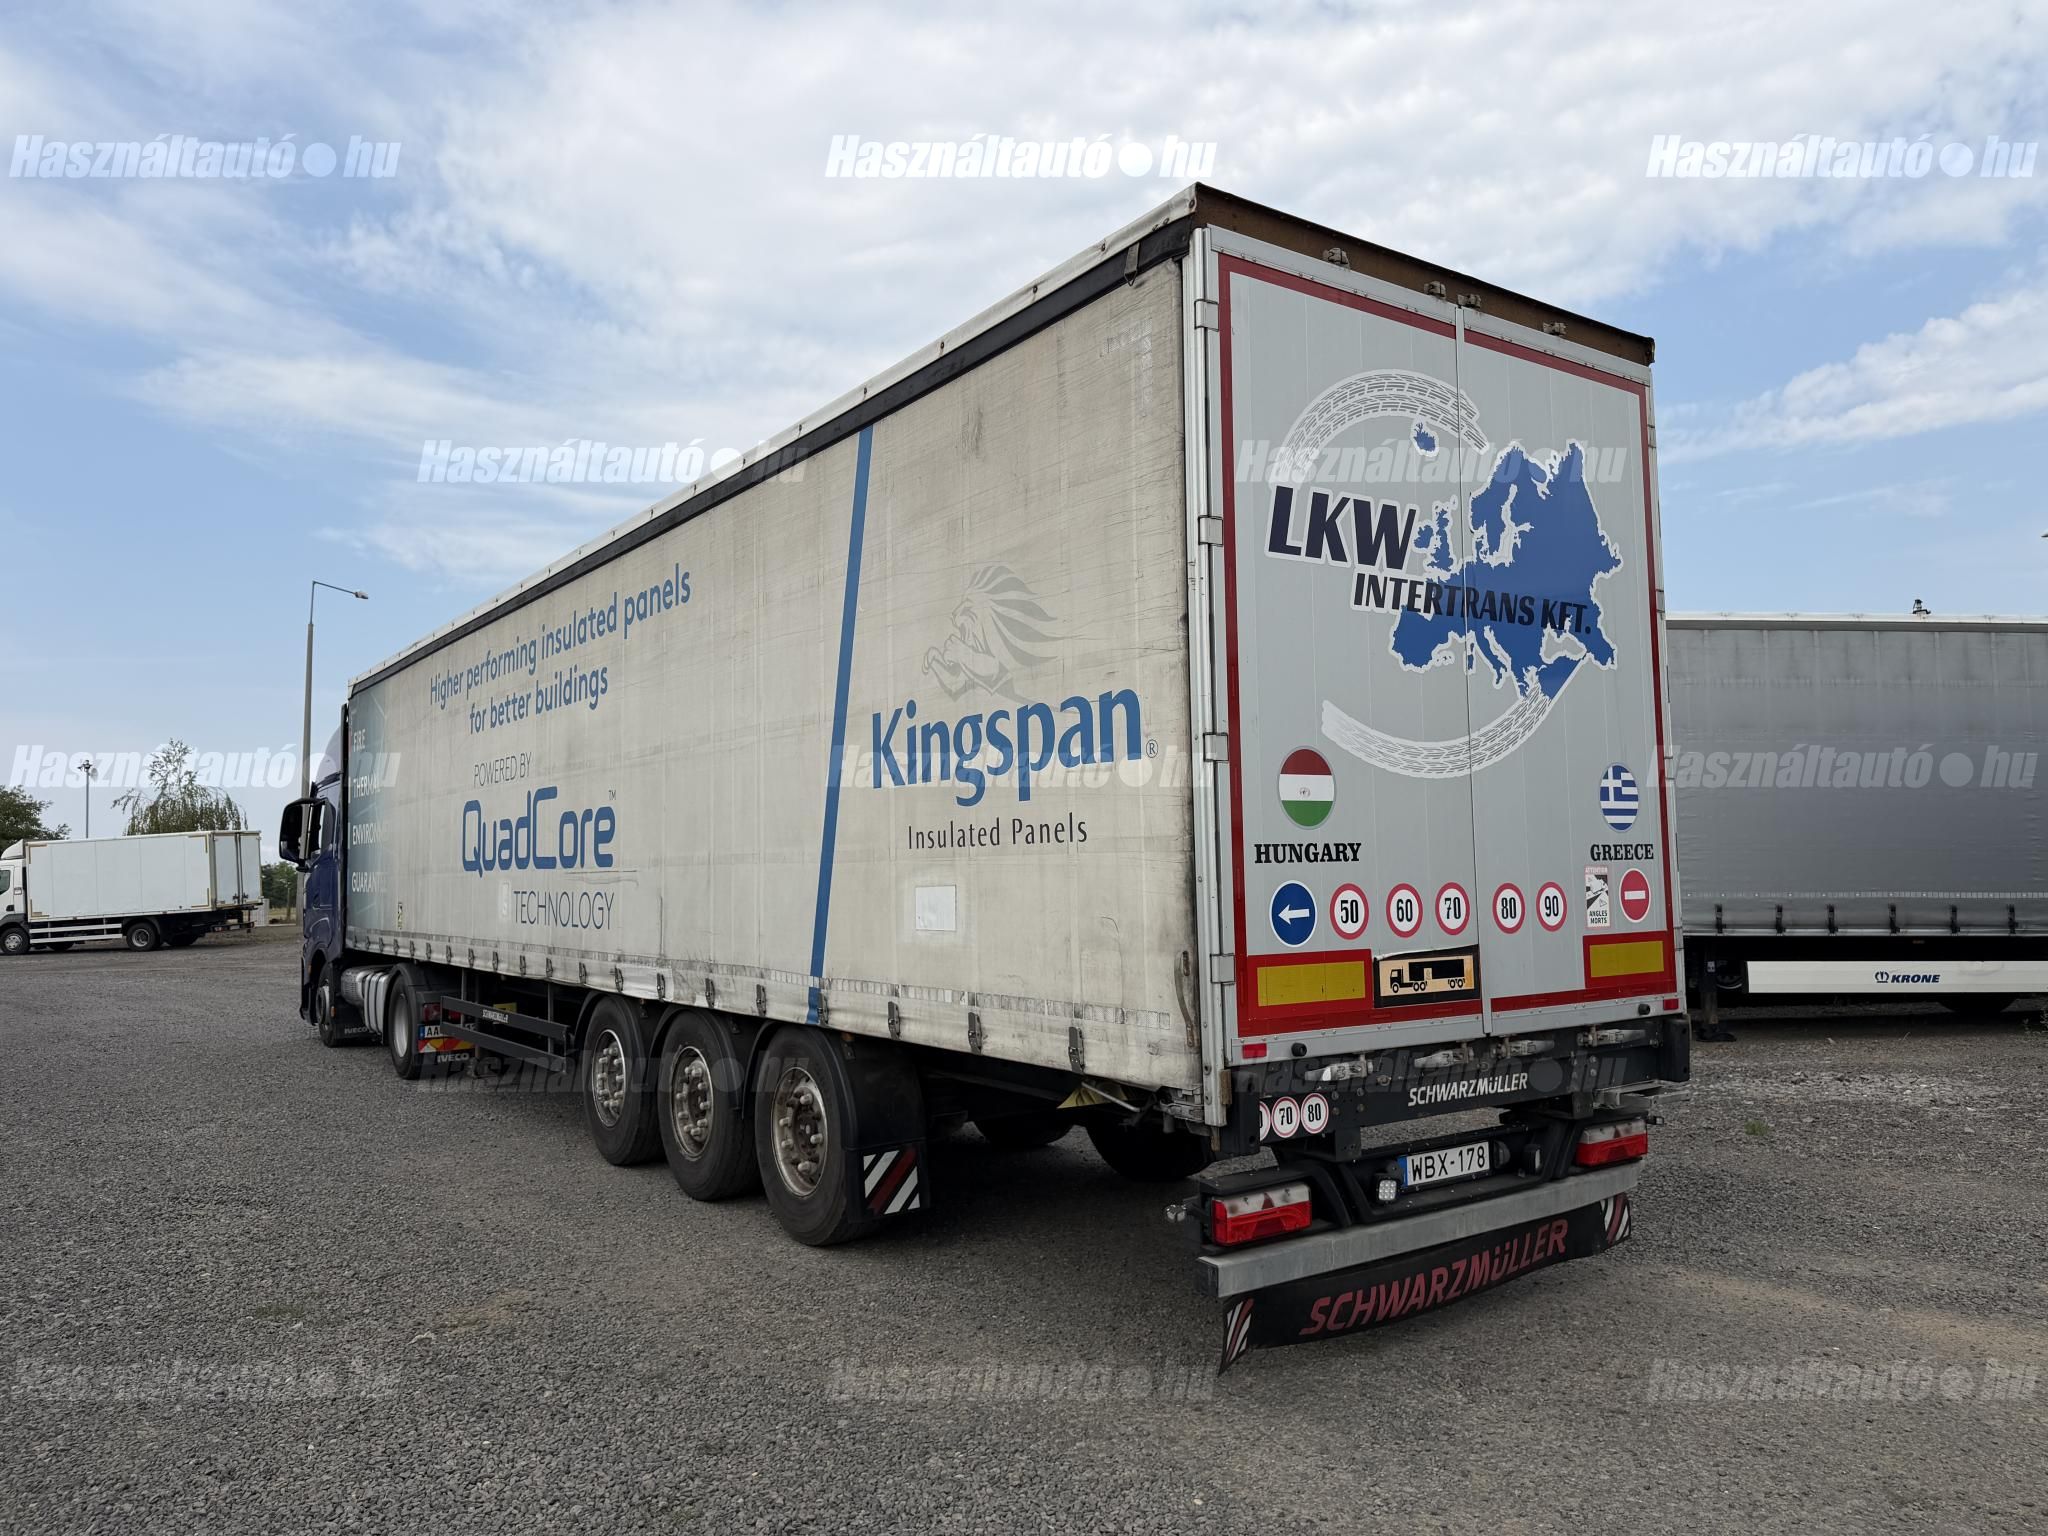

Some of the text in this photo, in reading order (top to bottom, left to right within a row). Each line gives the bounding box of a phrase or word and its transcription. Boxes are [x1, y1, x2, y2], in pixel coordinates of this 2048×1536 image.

[1268, 485, 1415, 570] LKW
[1353, 573, 1593, 634] INTERTRANS KFT.
[430, 563, 692, 711] Higher performing insulated panels
[469, 664, 609, 735] for better buildings
[354, 729, 366, 752] FIRE
[872, 688, 1143, 807] Kingspan
[473, 751, 532, 788] POWERED BY
[462, 785, 616, 878] QuadCore
[908, 812, 1088, 849] Insulated Panels
[1253, 842, 1362, 864] HUNGARY
[1590, 843, 1654, 861] GREECE
[513, 891, 615, 930] TECHNOLOGY
[1340, 899, 1359, 924] 50
[1396, 899, 1413, 923] 60
[1444, 897, 1461, 920] 70
[1500, 897, 1517, 920] 80
[1544, 895, 1560, 918] 90
[1890, 973, 1941, 984] KRONE
[436, 1052, 470, 1063] IVECO
[1407, 1071, 1529, 1107] SCHWARZMÜLLER
[1278, 1105, 1293, 1126] 70
[1307, 1103, 1322, 1122] 80
[1410, 1145, 1486, 1181] WBX-178
[1300, 1217, 1569, 1336] SCHWARZMÜLLER
